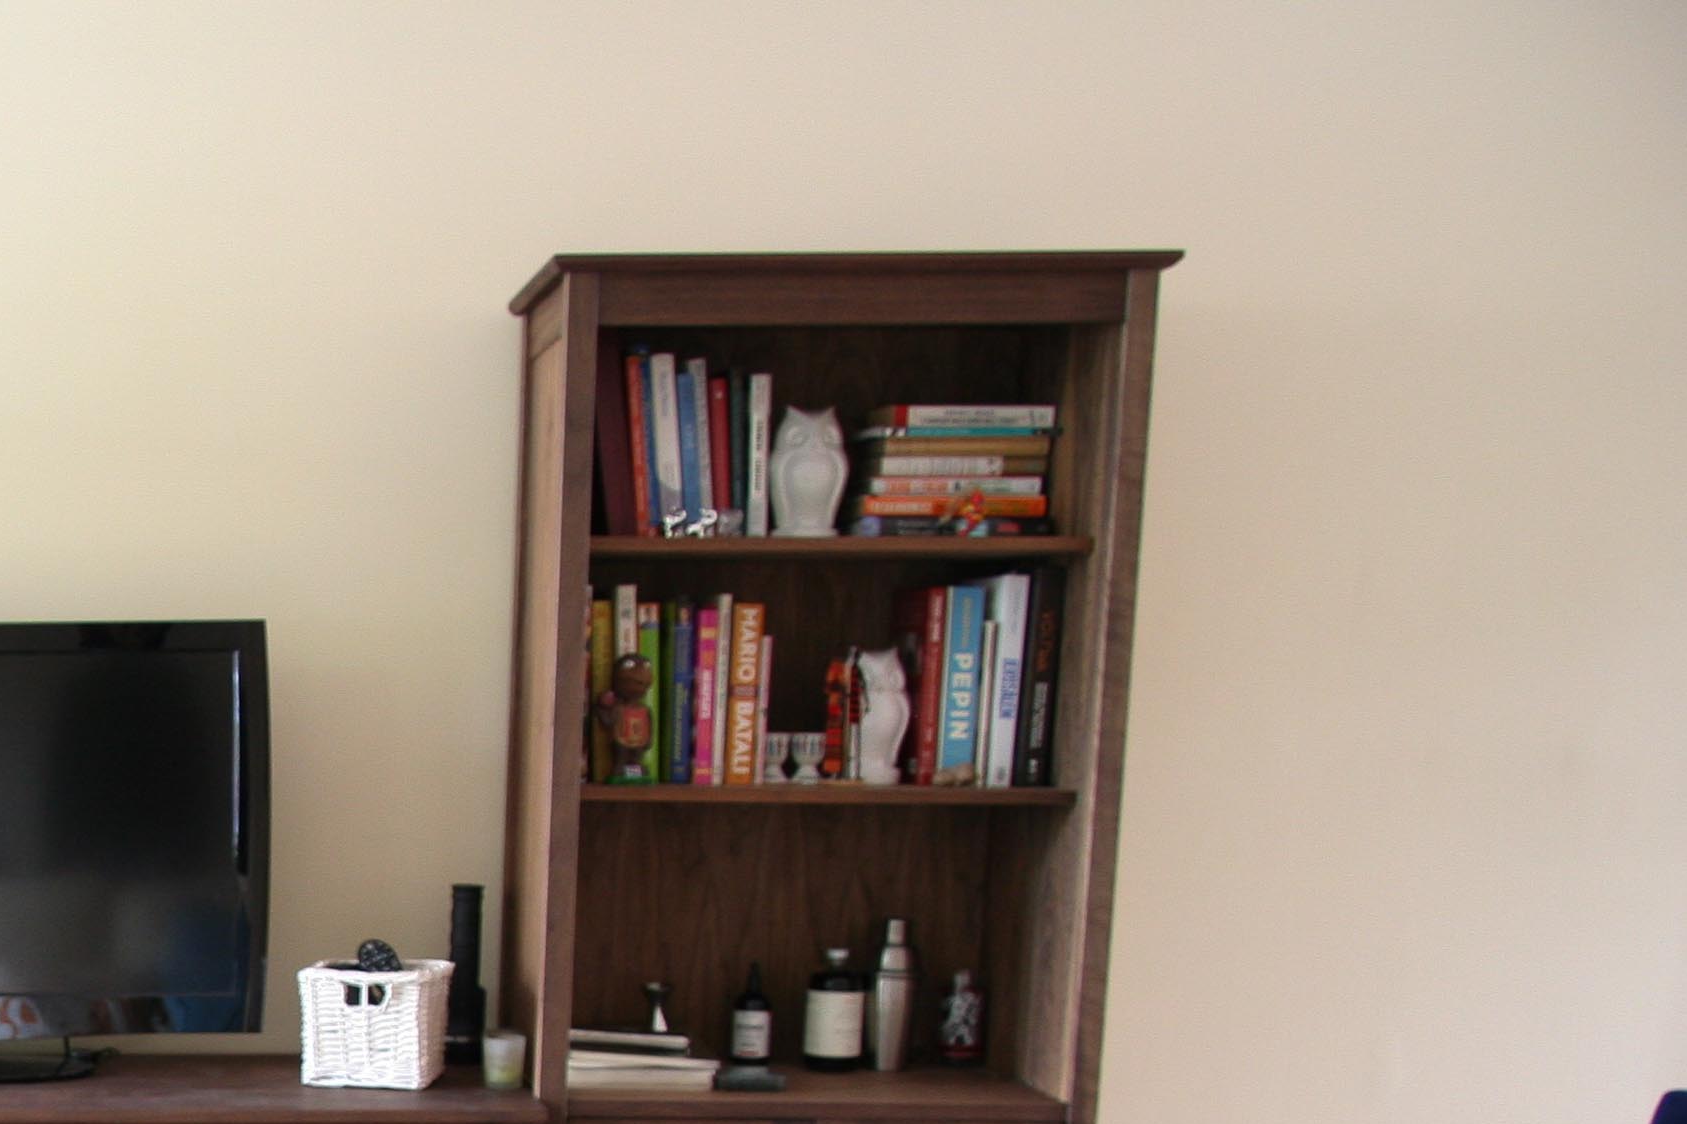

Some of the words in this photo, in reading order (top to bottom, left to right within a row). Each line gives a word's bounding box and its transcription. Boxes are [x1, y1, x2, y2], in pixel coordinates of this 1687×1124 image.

[738, 608, 761, 682] MARIO
[948, 652, 975, 740] PEPIN
[731, 702, 756, 775] BATALI
